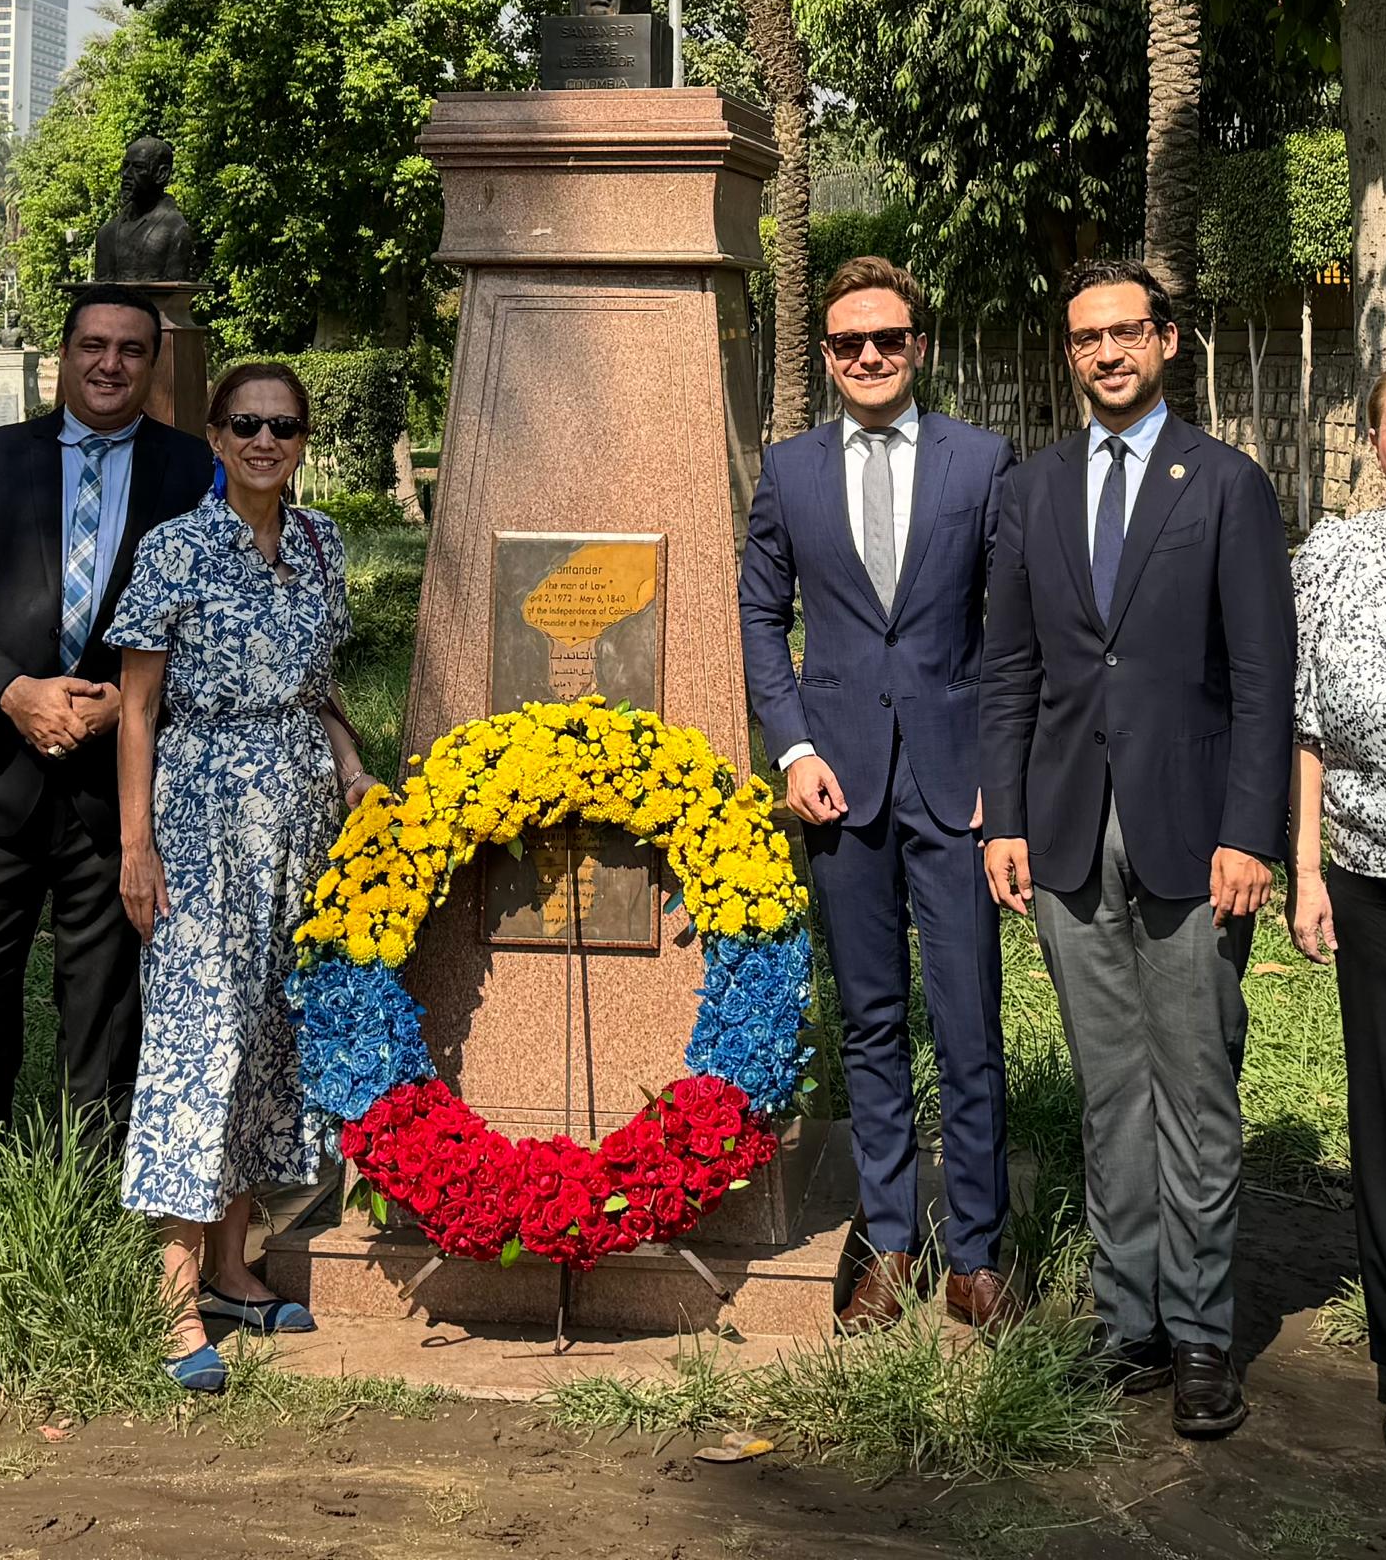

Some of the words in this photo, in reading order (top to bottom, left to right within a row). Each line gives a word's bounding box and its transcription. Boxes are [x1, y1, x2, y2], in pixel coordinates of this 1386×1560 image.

[560, 24, 635, 38] SANTANDER
[575, 42, 619, 55] HEROE
[559, 55, 635, 69] LIBERTADOR
[565, 77, 629, 89] COLOMBIA
[579, 580, 588, 590] of
[554, 593, 572, 603] 1972
[579, 595, 594, 605] May
[606, 594, 626, 603] 1840
[536, 606, 547, 615] the
[549, 606, 597, 616] Independence
[599, 606, 606, 615] of
[540, 618, 567, 626] Founder
[569, 618, 577, 627] of
[579, 618, 589, 627] the
